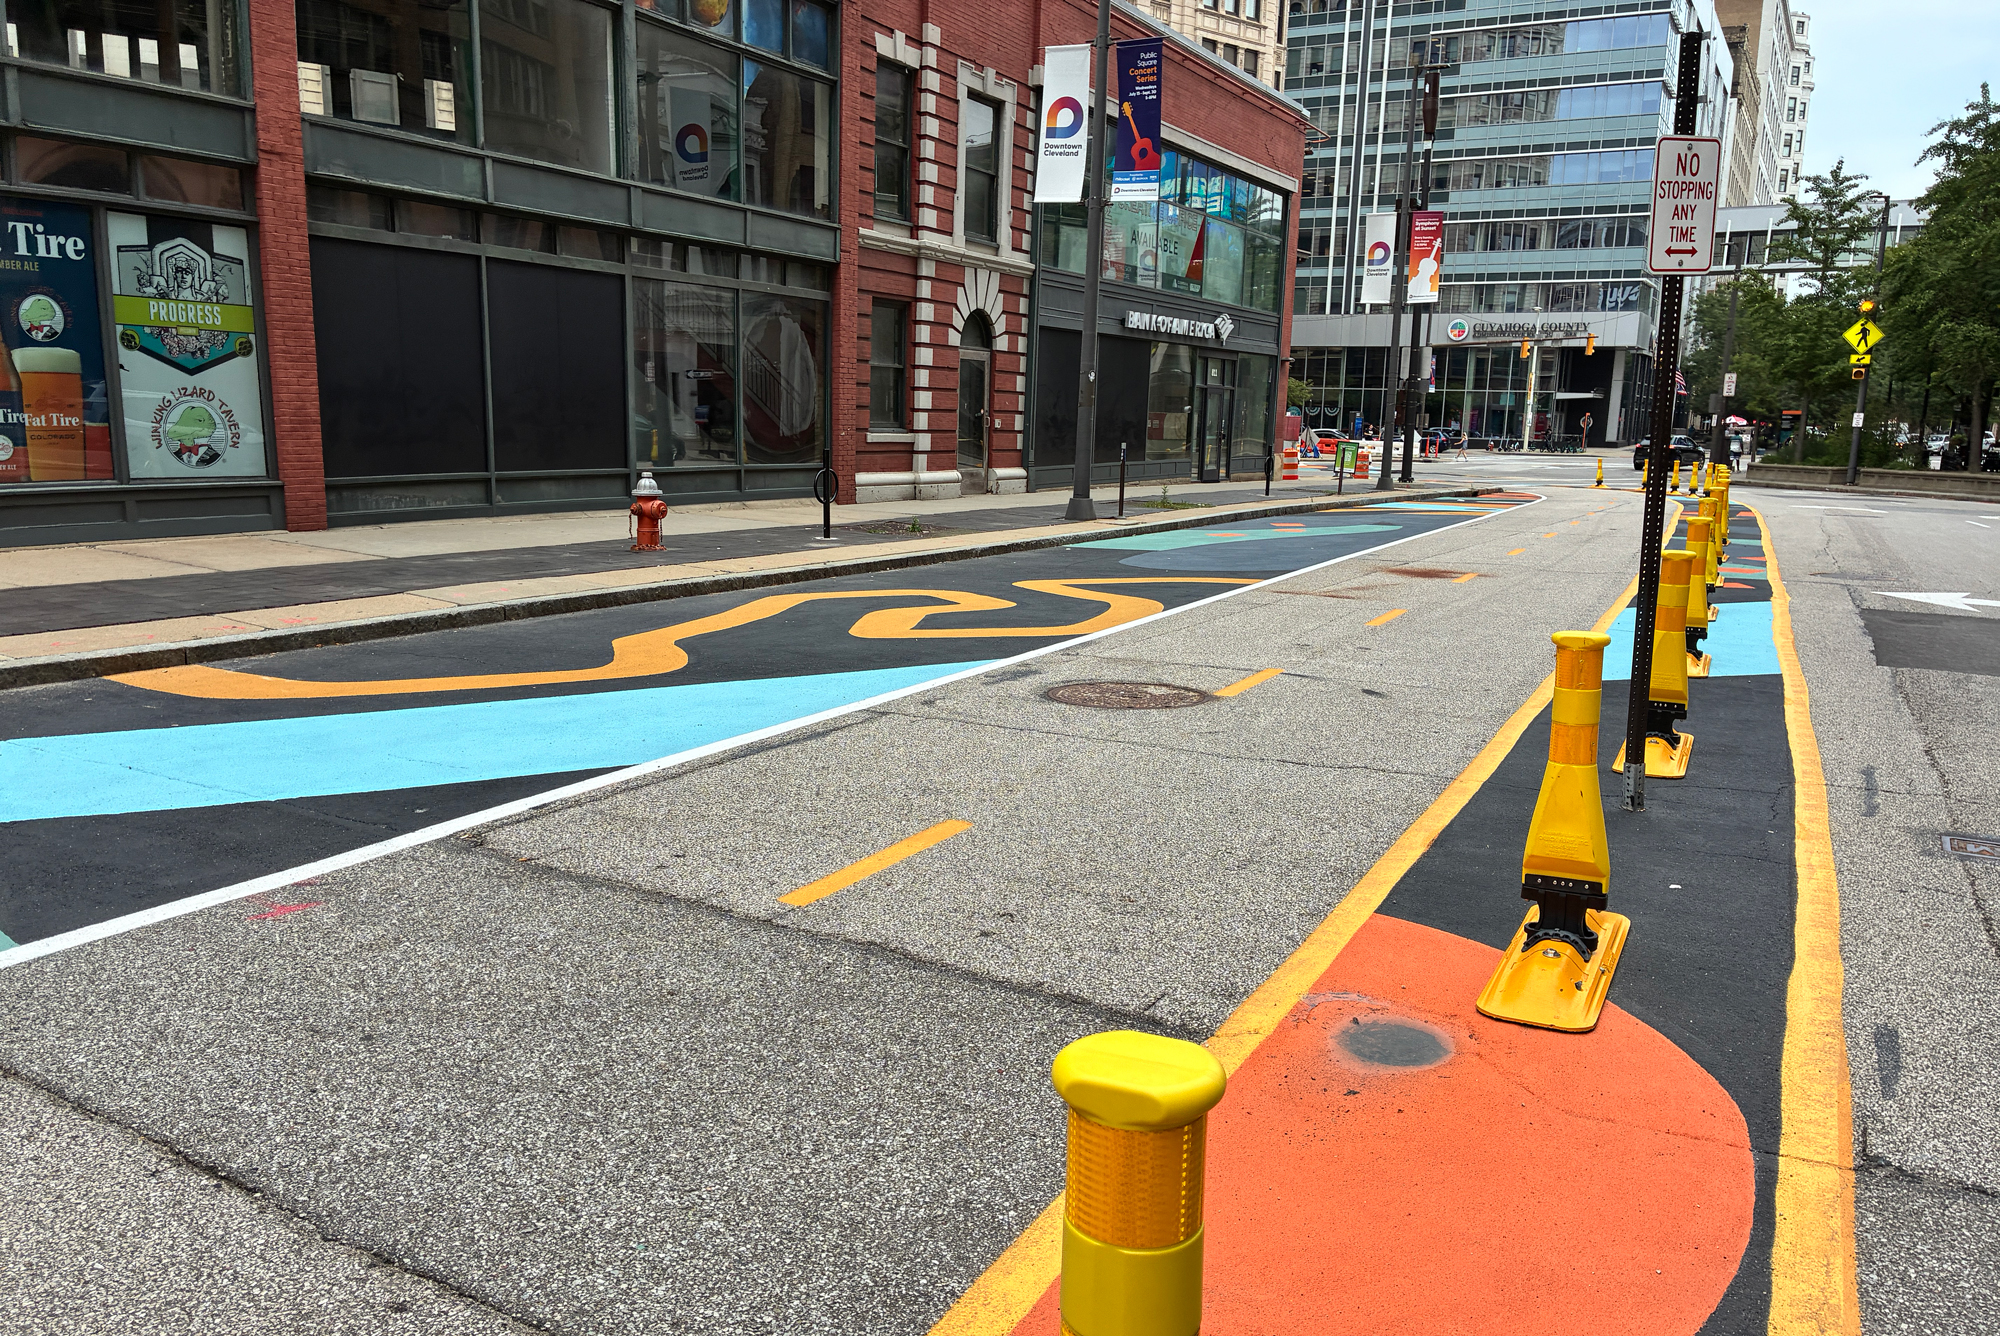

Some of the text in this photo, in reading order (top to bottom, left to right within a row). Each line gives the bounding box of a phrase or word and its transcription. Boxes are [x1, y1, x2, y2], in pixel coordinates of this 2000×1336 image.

[1128, 66, 1157, 76] Concert
[1137, 59, 1157, 67] Square
[1136, 75, 1157, 83] Series
[1044, 142, 1083, 150] Downtown
[1675, 152, 1700, 177] NO
[1658, 180, 1713, 200] STOPPING
[1671, 204, 1697, 221] ANY
[7, 221, 86, 261] Tire
[1130, 229, 1179, 255] AVAILABLE
[1669, 226, 1697, 243] TIME
[23, 261, 40, 272] ALE
[149, 300, 222, 326] PROGRESS
[1127, 310, 1216, 340] BANK OF AMERICA
[1472, 322, 1590, 332] CUYAHOGA COUNTY
[24, 413, 80, 427] Fat Tire
[151, 385, 241, 449] WINKING LIZARD TAVERN
